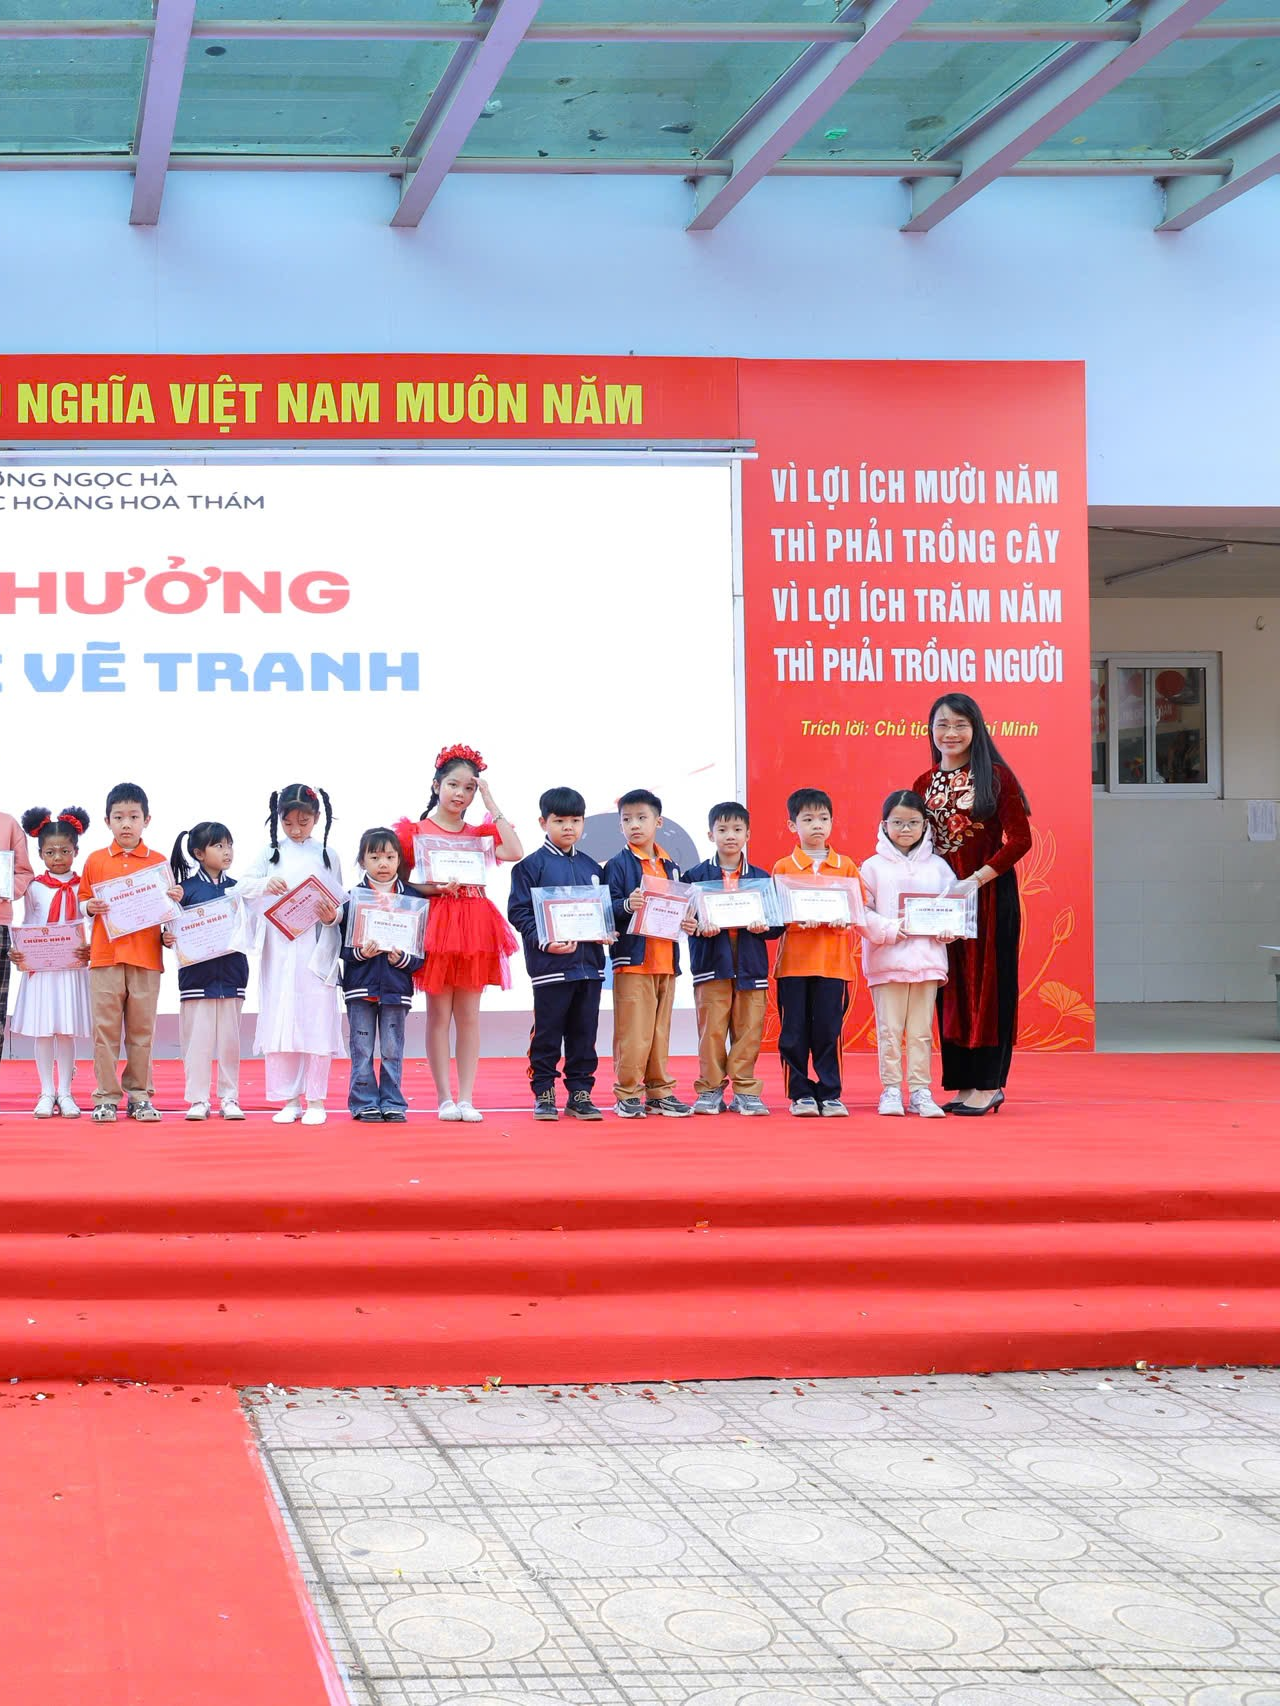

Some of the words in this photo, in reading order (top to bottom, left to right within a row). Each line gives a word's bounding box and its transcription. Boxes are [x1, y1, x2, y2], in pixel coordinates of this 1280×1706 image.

[17, 375, 155, 423] NGHĨA
[170, 375, 263, 433] VIỆT
[277, 383, 380, 423] NAM
[396, 375, 527, 423] MUÔN
[543, 376, 642, 424] NĂM
[13, 491, 113, 510] HOÀNG
[120, 496, 180, 510] HOA
[187, 491, 265, 510] THÁM
[54, 473, 132, 490] NGỌC
[140, 469, 177, 487] HÀ
[771, 462, 797, 503] VÌ
[807, 465, 849, 510] LỢI
[859, 462, 905, 504] ÍCH
[914, 462, 985, 504] MƯỜI
[995, 464, 1058, 505] NĂM
[770, 521, 816, 562] THÌ
[826, 517, 893, 562] PHẢI
[902, 517, 996, 564] TRỒNG
[1006, 522, 1060, 564] CÂY
[772, 580, 798, 622] VÌ
[808, 584, 850, 629] LỢI
[859, 580, 906, 622] ÍCH
[913, 581, 991, 623] TRĂM
[999, 581, 1062, 623] NĂM
[23, 641, 126, 692] VẼ
[143, 652, 420, 692] TRANH
[773, 640, 814, 682] THÌ
[822, 636, 883, 682] PHẢI
[890, 636, 976, 683] TRỒNG
[984, 640, 1063, 683] NGƯỜI
[801, 719, 841, 736] Trích
[845, 719, 869, 736] lời:
[874, 718, 906, 737] Chủ
[910, 719, 928, 740] tịc
[1000, 720, 1039, 737] Minh
